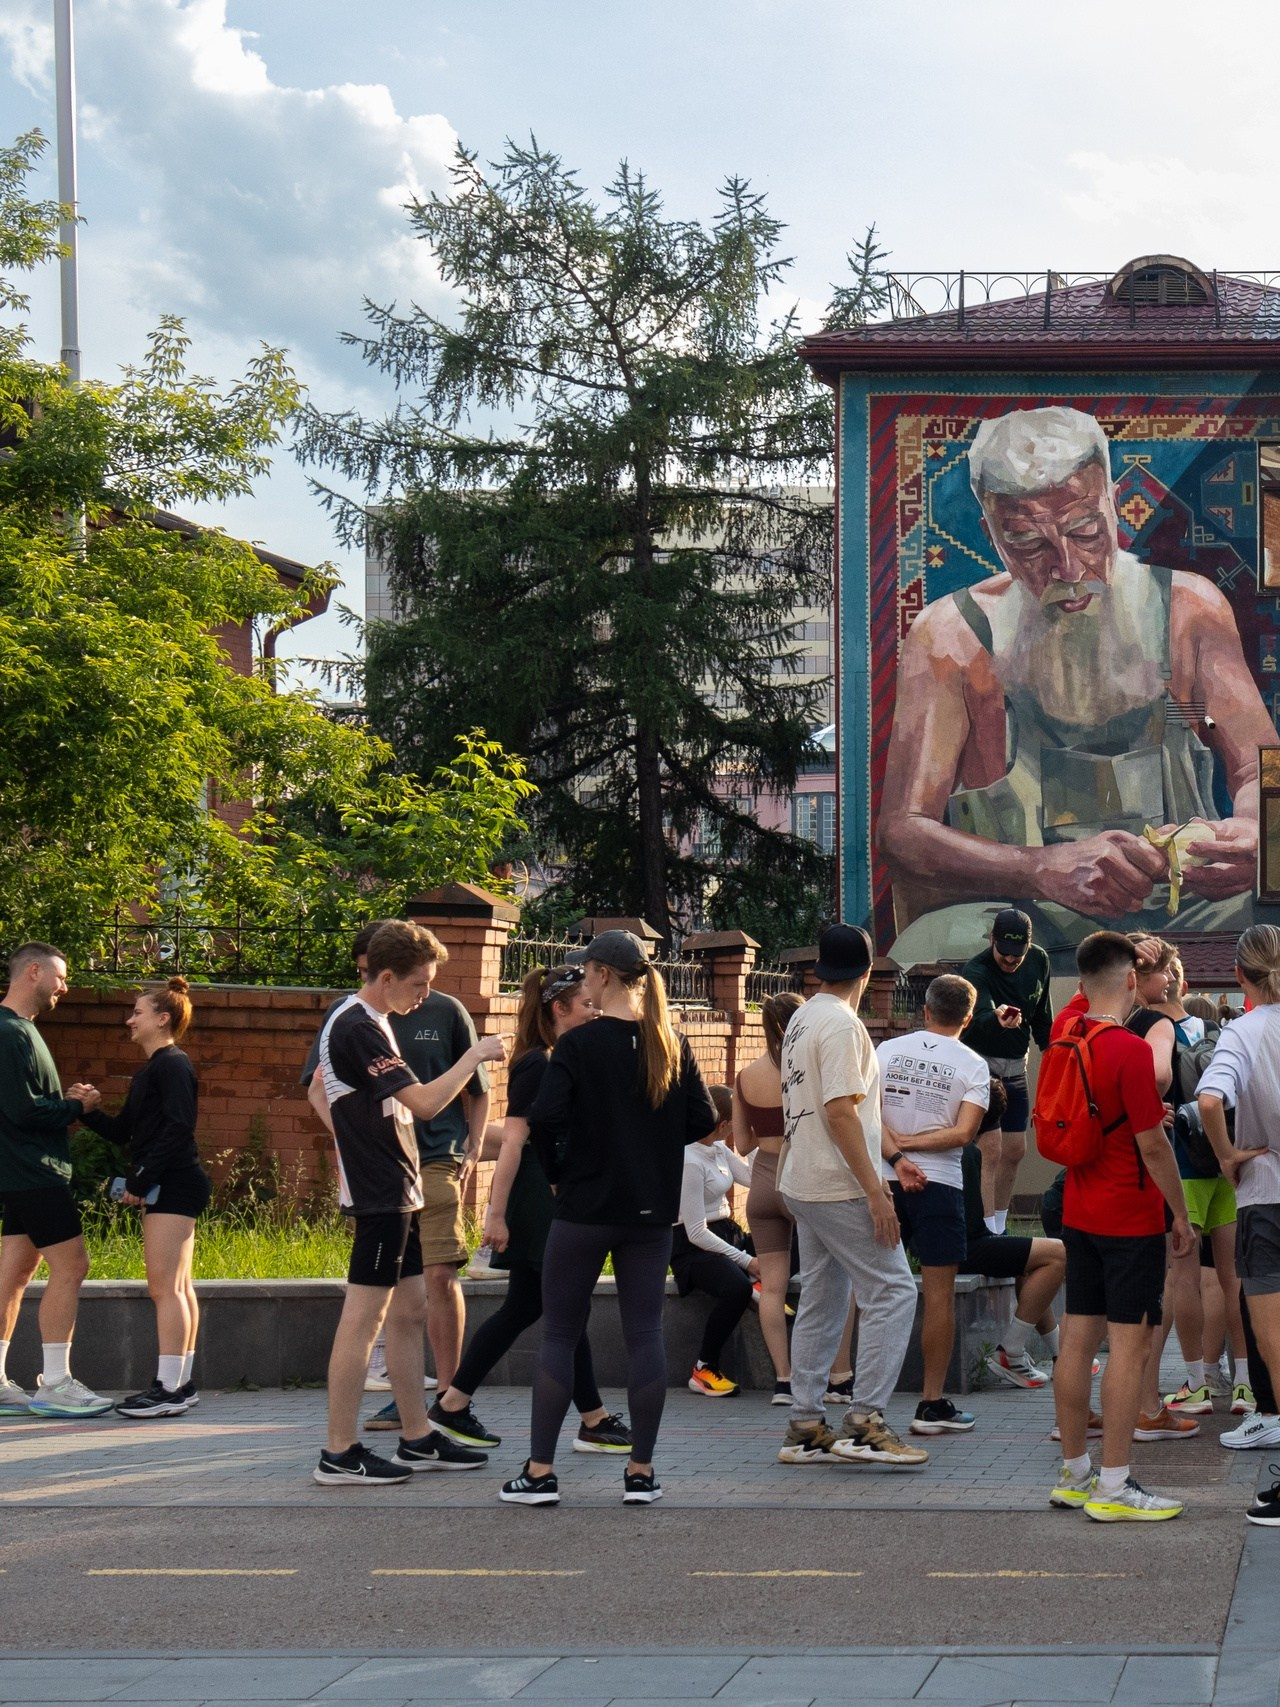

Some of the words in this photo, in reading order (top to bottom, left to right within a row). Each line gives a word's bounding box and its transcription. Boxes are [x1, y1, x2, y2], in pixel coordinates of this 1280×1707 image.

[885, 1072, 910, 1083] ЛЮБИ
[910, 1076, 925, 1086] БЕГ
[932, 1081, 952, 1092] СЕБЕ
[1244, 1422, 1265, 1437] HOKA
